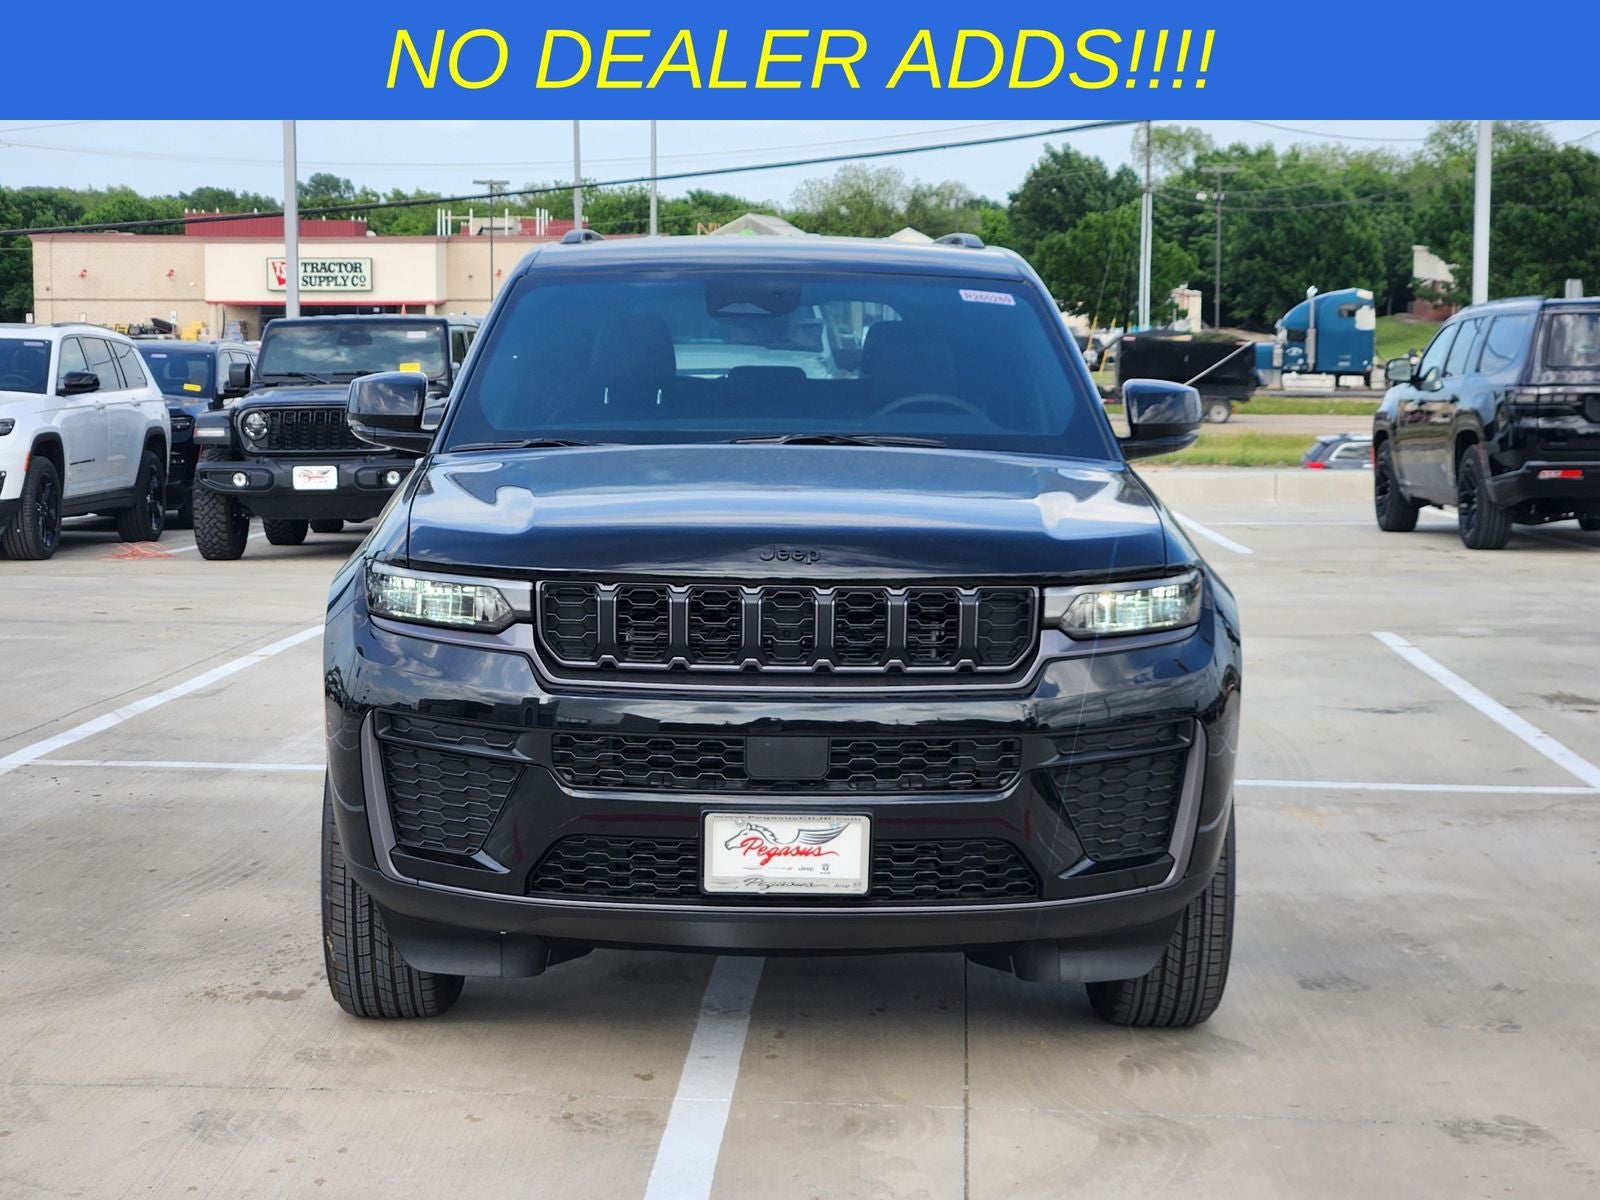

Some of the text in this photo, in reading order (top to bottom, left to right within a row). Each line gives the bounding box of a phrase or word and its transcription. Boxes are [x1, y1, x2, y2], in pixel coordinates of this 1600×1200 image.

[301, 262, 362, 273] TRACTOR
[301, 275, 349, 286] SUPPLY
[760, 544, 820, 565] Jeep
[740, 837, 840, 866] Pegasus
